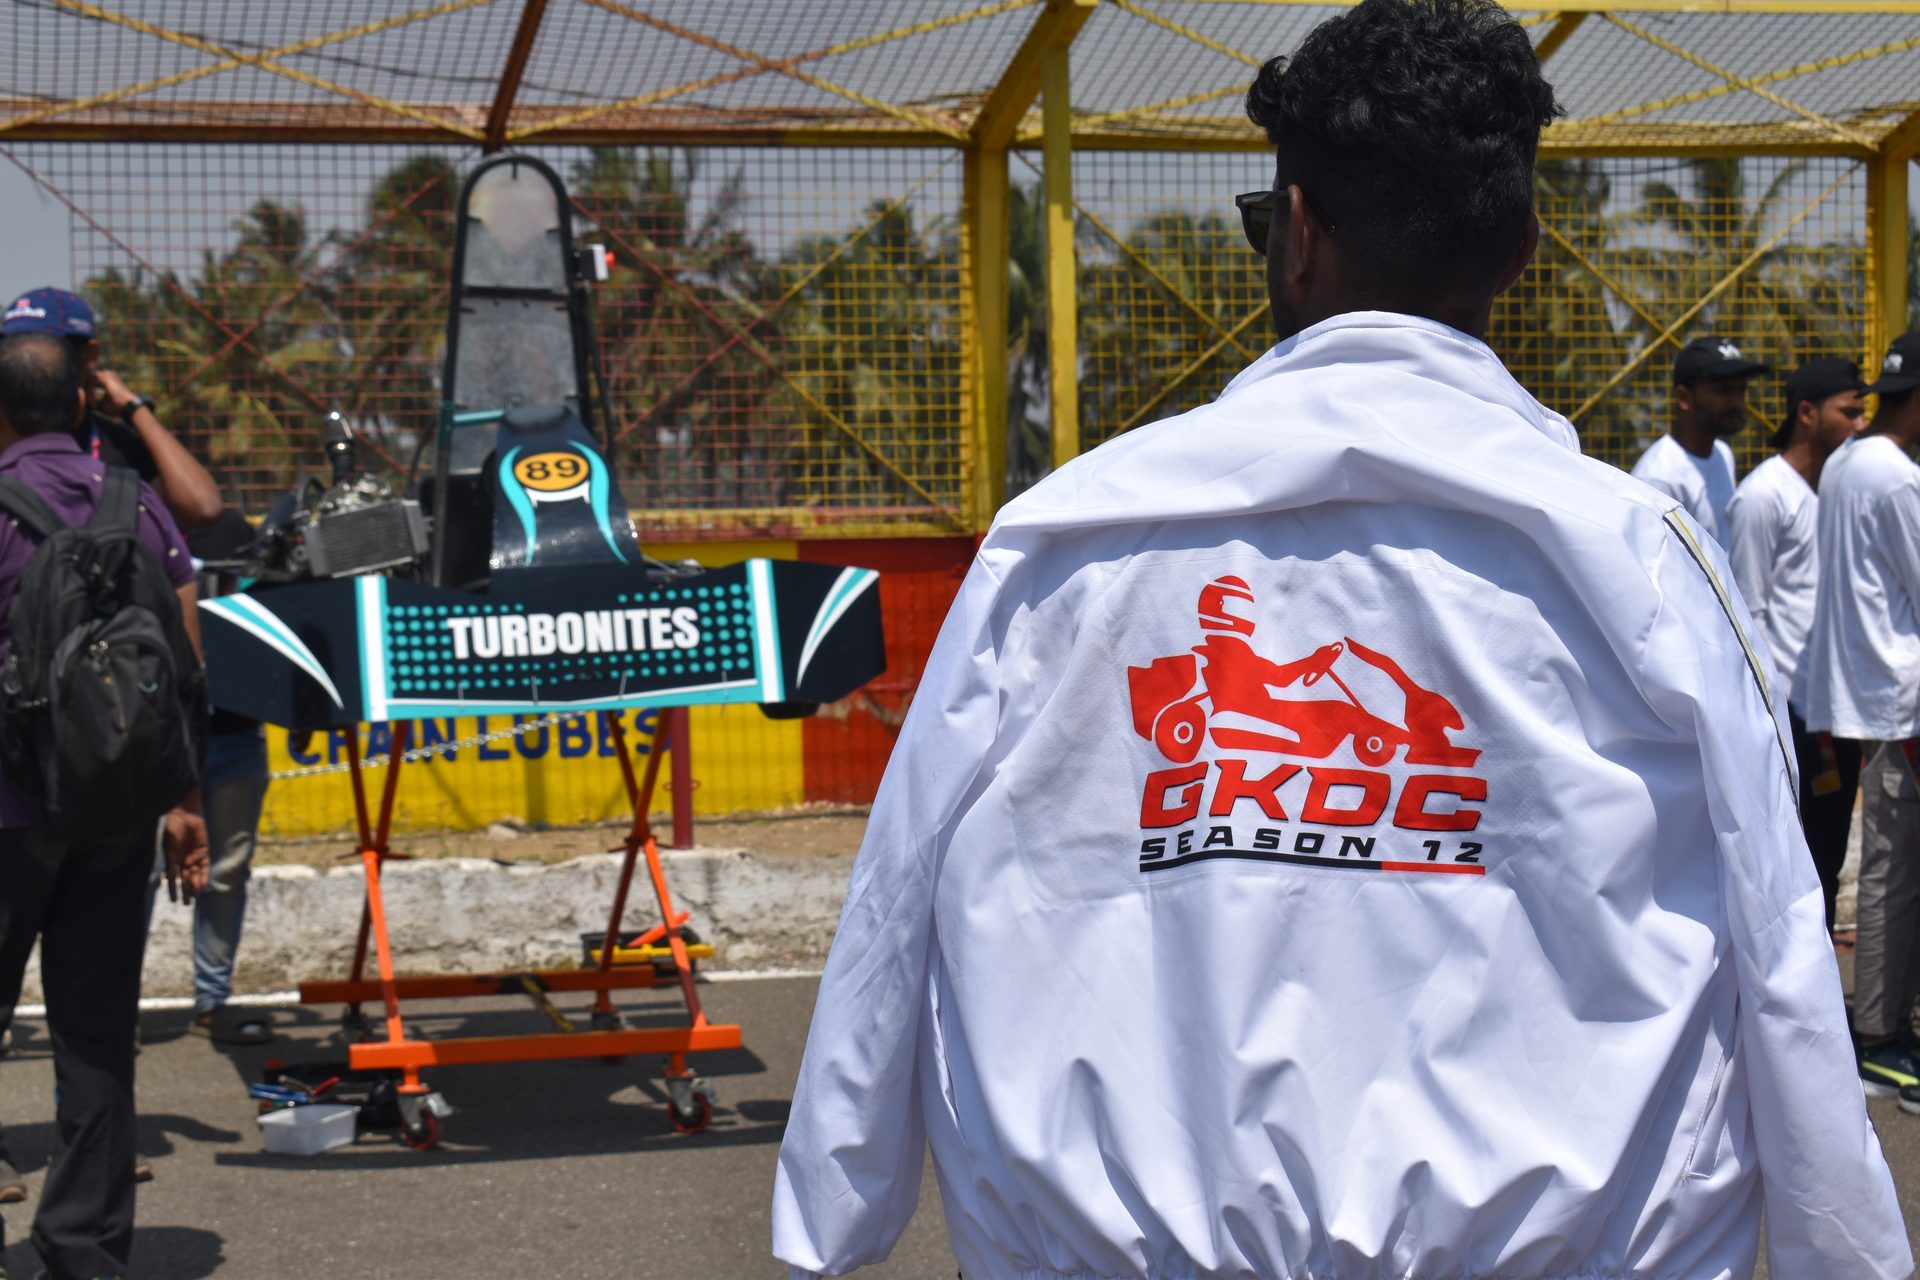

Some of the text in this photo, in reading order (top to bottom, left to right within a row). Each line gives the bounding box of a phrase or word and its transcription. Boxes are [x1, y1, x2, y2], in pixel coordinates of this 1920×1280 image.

[525, 458, 581, 481] 89
[446, 606, 701, 660] TURBONITES
[476, 703, 672, 762] LUBES
[1139, 759, 1488, 832] GKDC
[1139, 825, 1484, 863] SEASON 12
